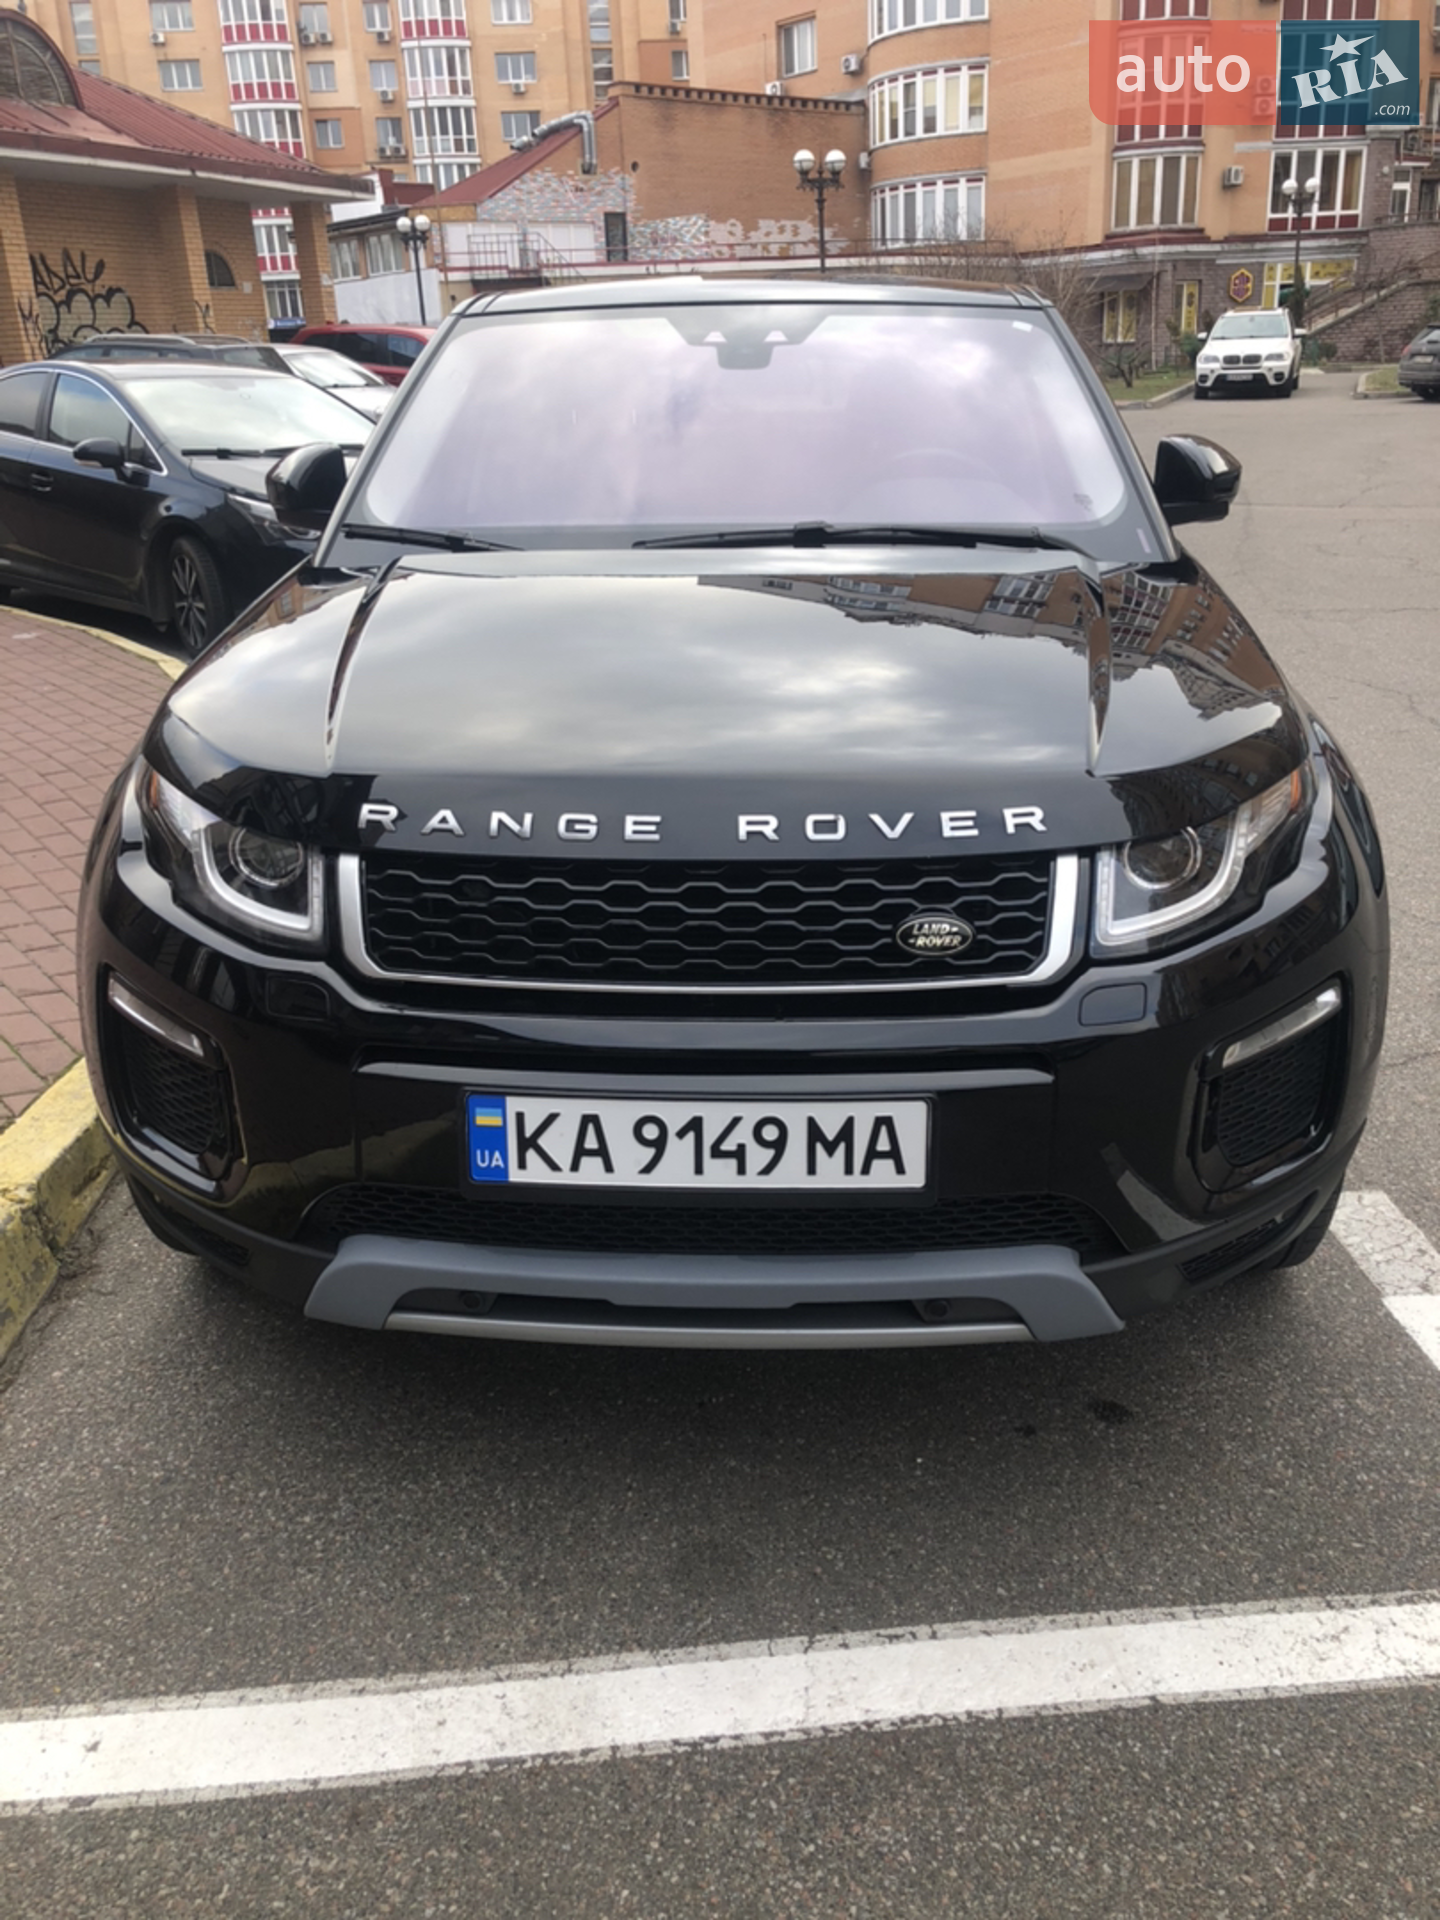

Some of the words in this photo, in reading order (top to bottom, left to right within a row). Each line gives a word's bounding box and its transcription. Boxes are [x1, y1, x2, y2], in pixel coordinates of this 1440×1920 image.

[357, 802, 662, 842] RANGE
[737, 805, 1048, 842] ROVER
[475, 1148, 505, 1169] UA
[514, 1110, 616, 1174] KA
[631, 1114, 790, 1177] 9149
[805, 1114, 907, 1177] MA
